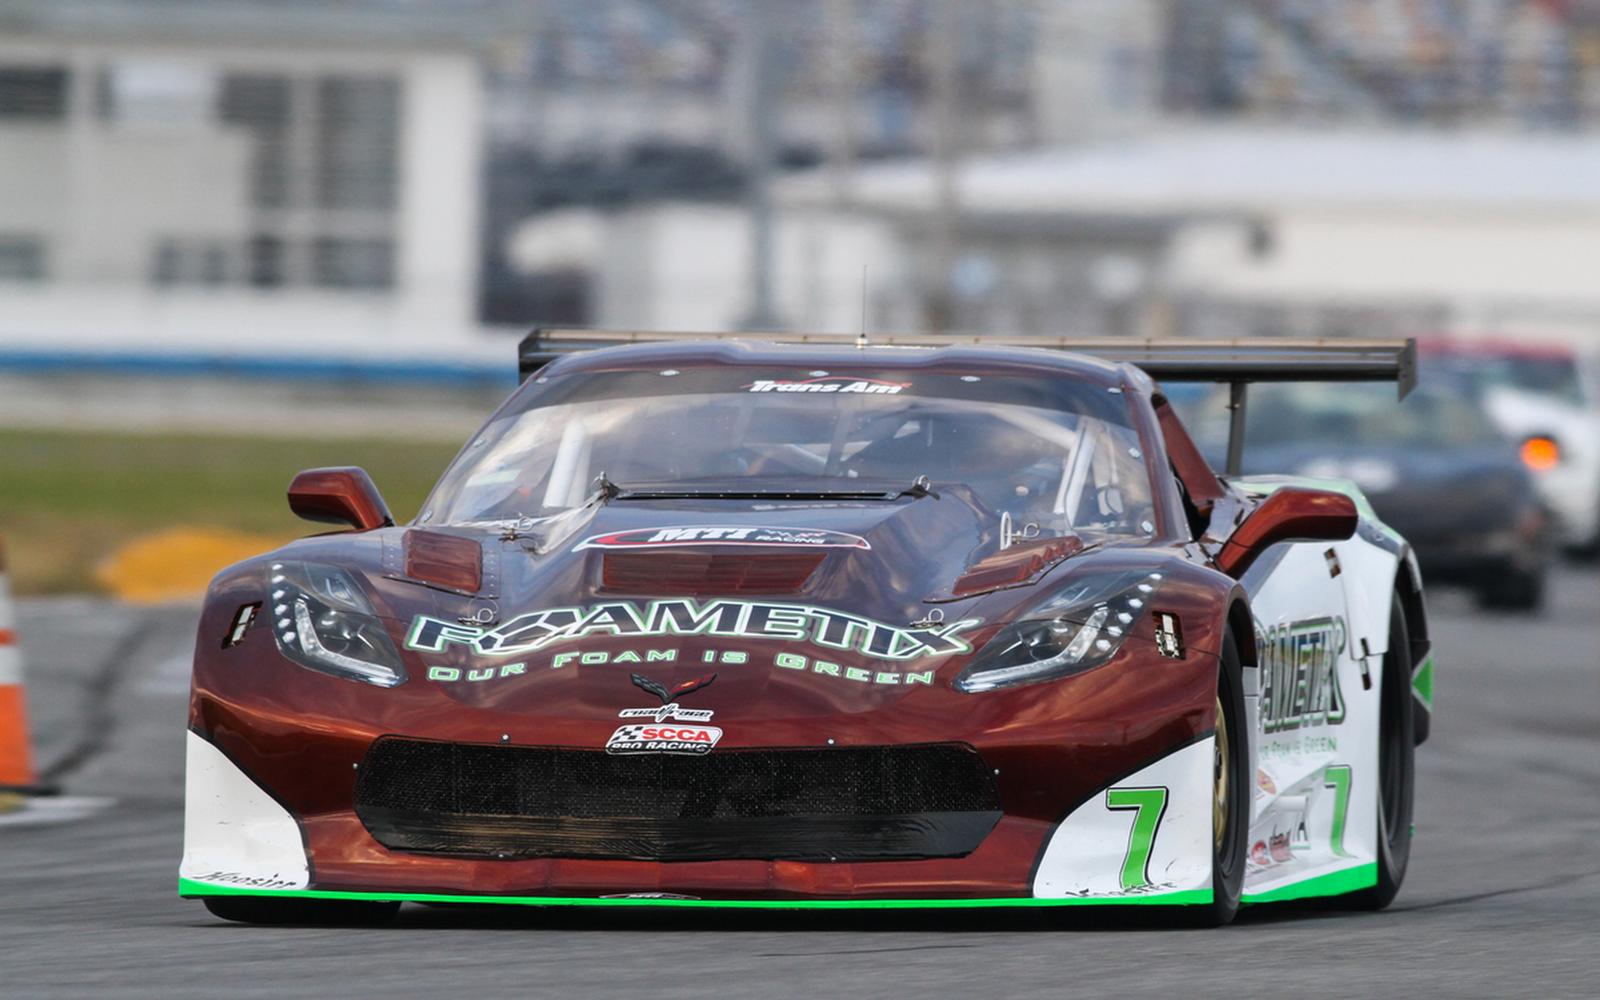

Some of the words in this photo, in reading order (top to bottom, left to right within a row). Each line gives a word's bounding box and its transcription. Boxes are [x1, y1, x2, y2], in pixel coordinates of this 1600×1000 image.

[750, 380, 842, 393] Trans
[838, 381, 902, 394] Am
[648, 527, 758, 543] MTI
[755, 534, 826, 545] RACING
[428, 662, 527, 682] OUR
[552, 649, 676, 669] FOAM
[703, 649, 748, 664] IS
[775, 652, 932, 684] GREEN
[641, 727, 712, 742] SCCA
[645, 741, 709, 752] RACING
[1323, 763, 1353, 858] 7
[1106, 786, 1168, 888] 7
